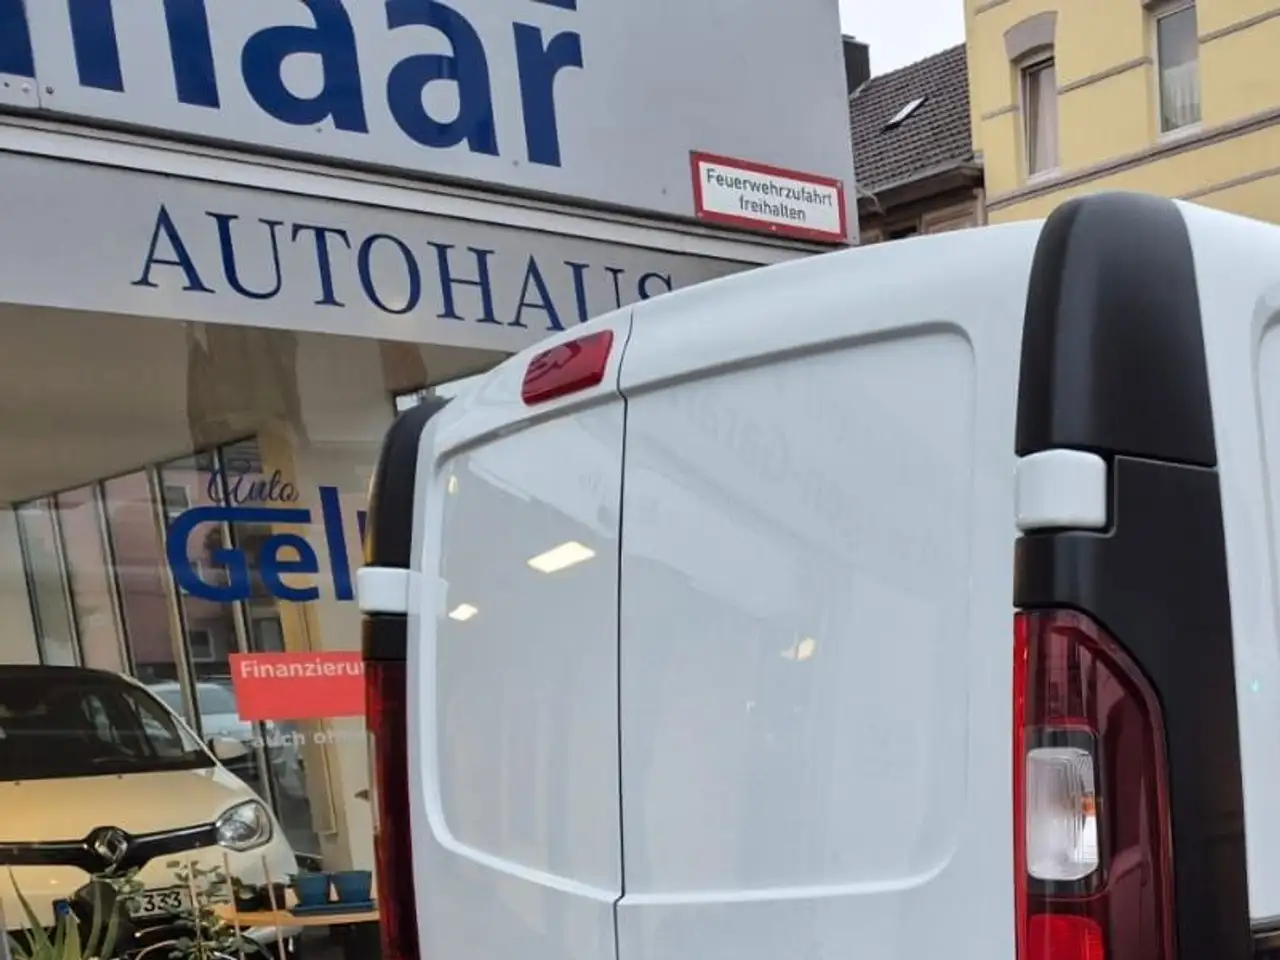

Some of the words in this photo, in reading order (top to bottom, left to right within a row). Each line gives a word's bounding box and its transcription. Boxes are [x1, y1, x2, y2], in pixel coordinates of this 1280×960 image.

[706, 167, 833, 207] Feuerwehrzufahrt
[739, 194, 806, 221] freihalten
[166, 486, 368, 603] Gel
